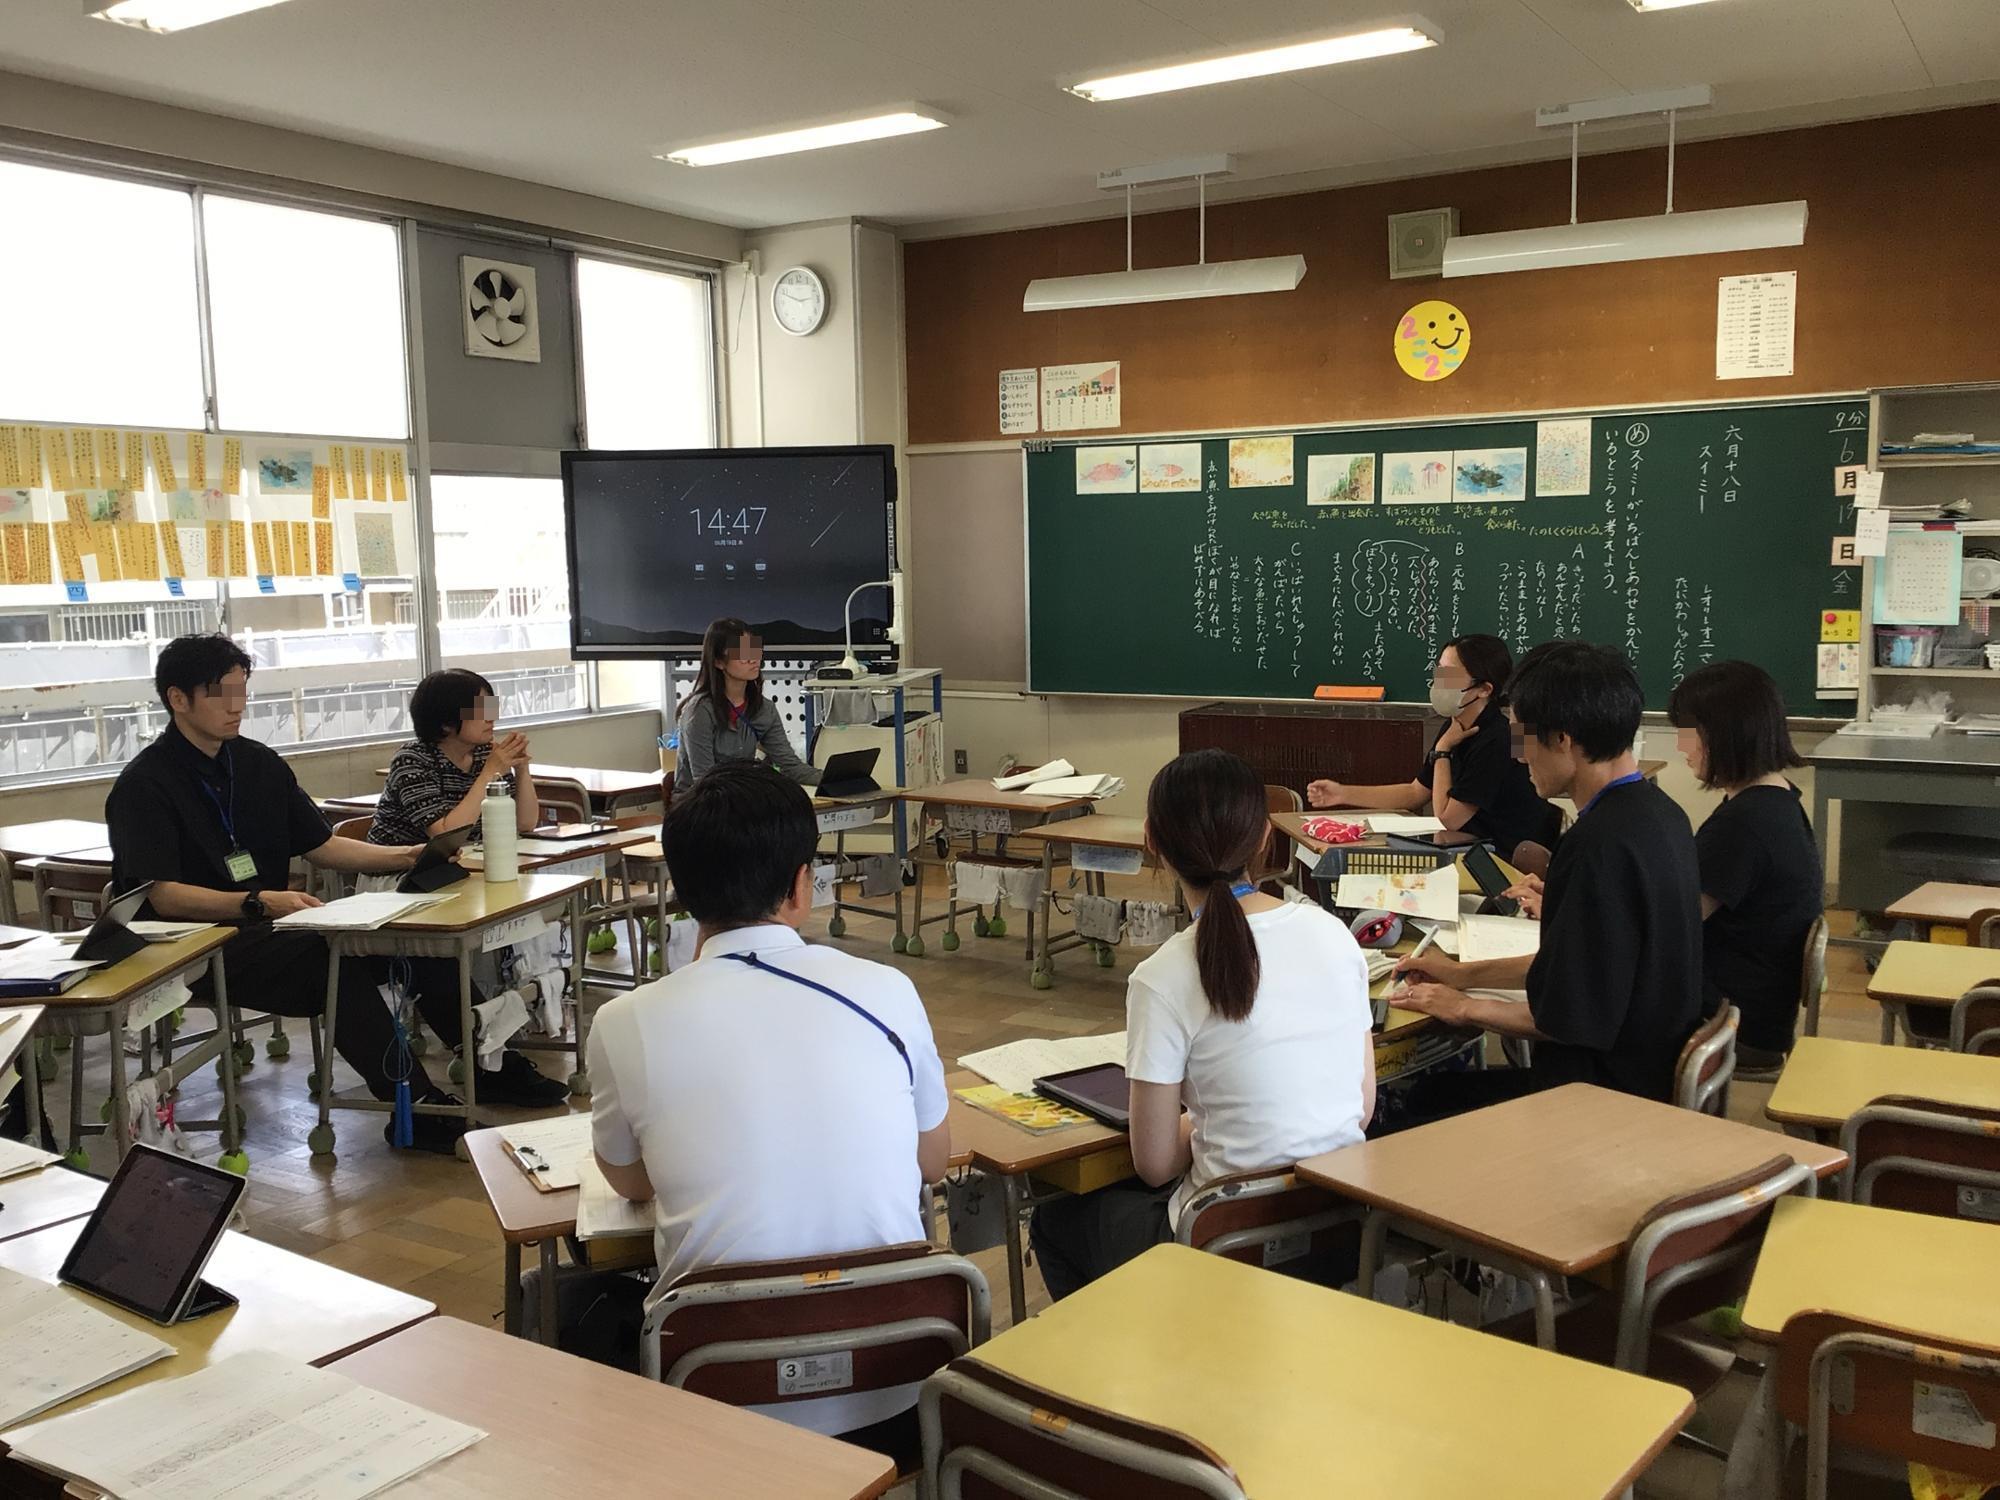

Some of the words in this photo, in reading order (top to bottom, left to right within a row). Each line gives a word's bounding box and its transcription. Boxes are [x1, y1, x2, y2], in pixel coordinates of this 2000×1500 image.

[1721, 424, 1744, 503] 六月十八日
[1698, 444, 1713, 514] スイミー
[1842, 471, 1857, 490] 月
[690, 507, 767, 535] 14:47
[1603, 430, 1619, 595] いるところを考えよう。
[1290, 541, 1302, 557] C
[1455, 542, 1465, 556] B
[1571, 543, 1585, 559] A
[1840, 543, 1855, 560] 日
[1387, 551, 1402, 631] もうこわくない。
[1832, 569, 1853, 594] 金
